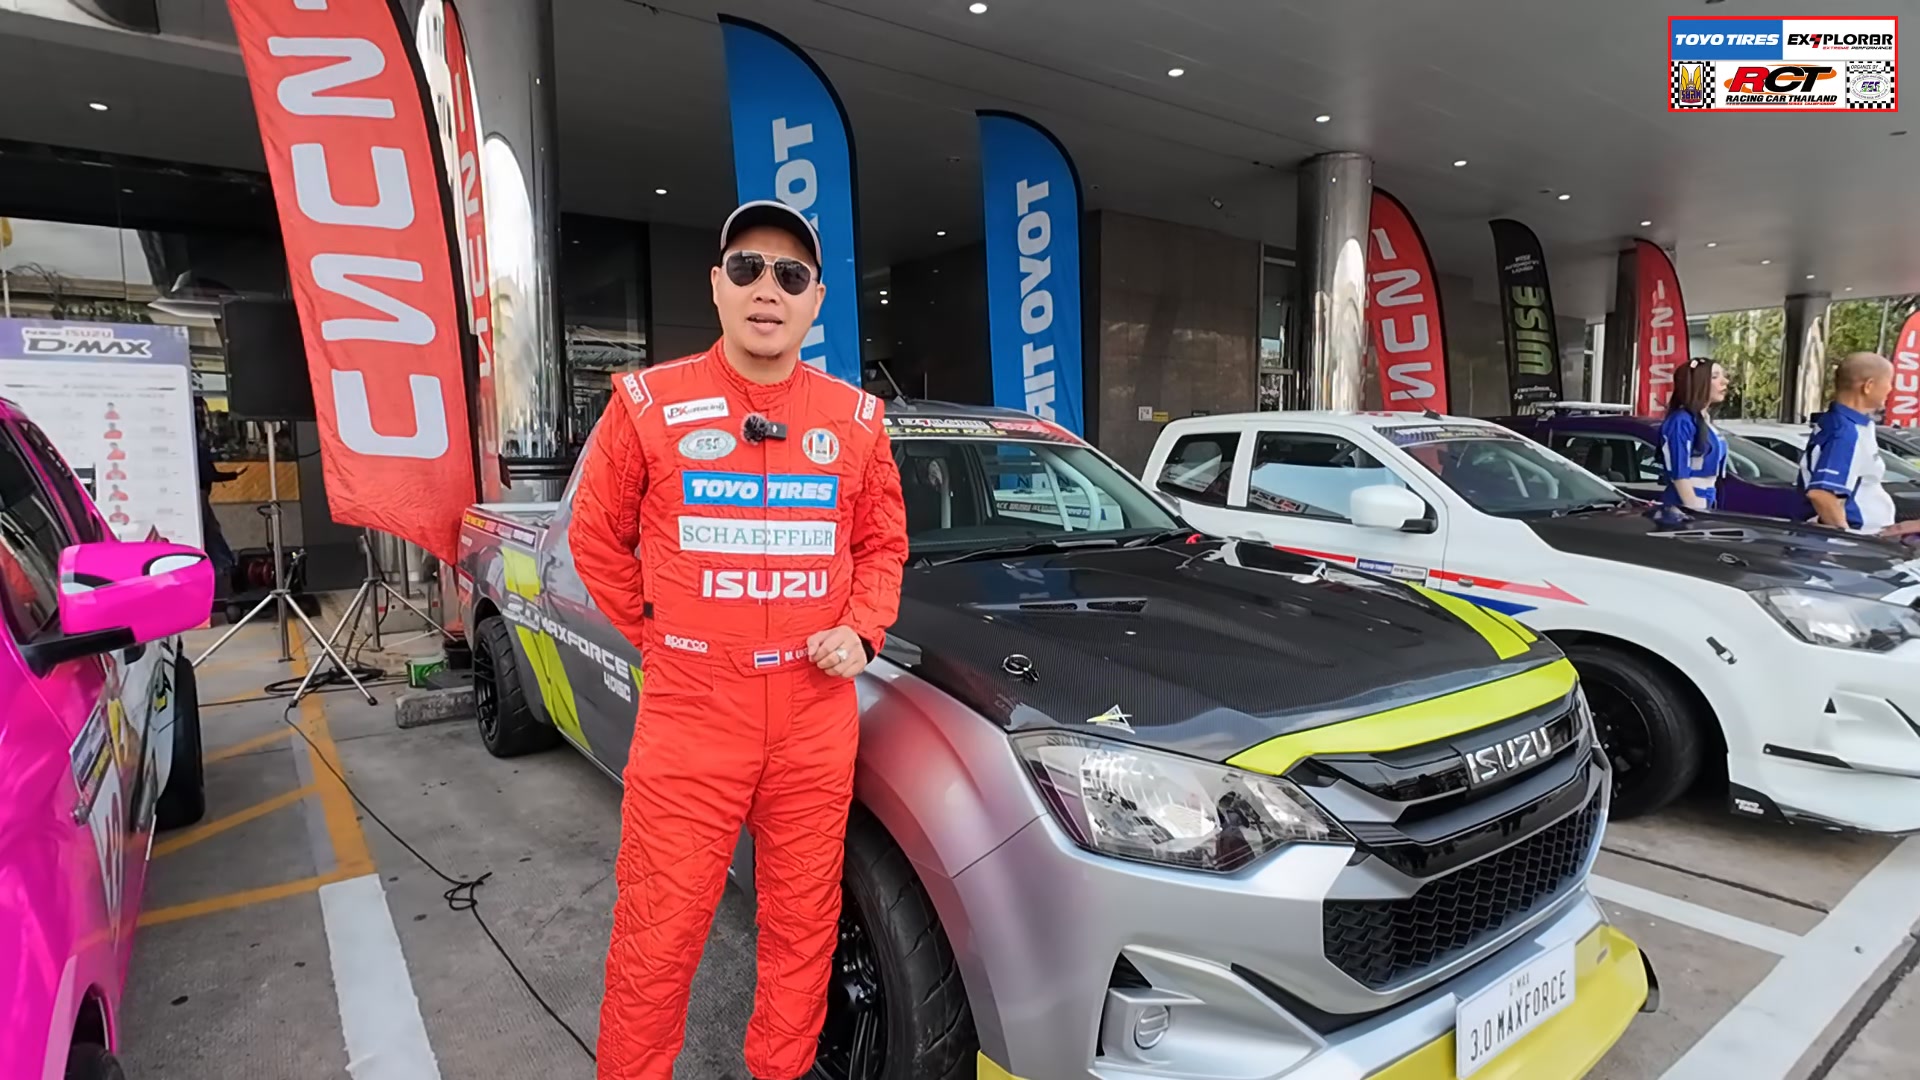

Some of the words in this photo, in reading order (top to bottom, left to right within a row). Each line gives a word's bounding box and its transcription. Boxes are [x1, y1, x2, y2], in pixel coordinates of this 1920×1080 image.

[1511, 285, 1554, 377] WISE
[691, 478, 759, 500] TOYO
[767, 481, 833, 501] TIRES
[682, 524, 833, 548] SCHAEFFLER
[702, 570, 828, 600] ISUZU
[1465, 726, 1553, 785] ISUZU
[1470, 1018, 1493, 1062] 3.0
[1496, 967, 1567, 1043] MAXFORCE
